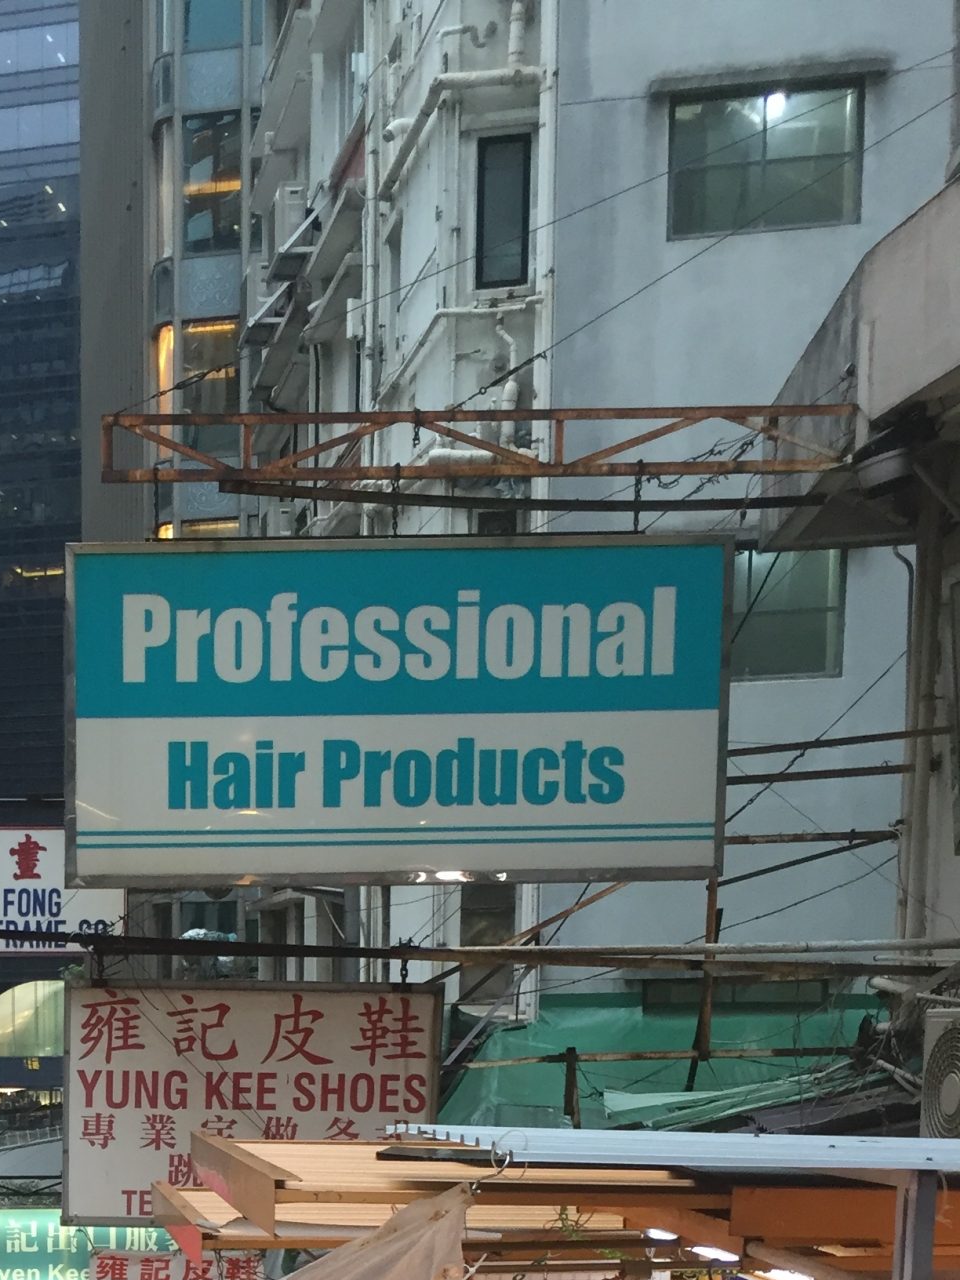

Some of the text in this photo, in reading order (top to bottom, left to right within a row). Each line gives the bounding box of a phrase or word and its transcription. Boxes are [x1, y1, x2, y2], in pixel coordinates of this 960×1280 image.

[121, 586, 677, 684] Professional
[167, 736, 626, 810] Hair Products
[2, 887, 62, 918] FONG
[77, 989, 428, 1067] 雍記皮鞋
[76, 1069, 427, 1113] YUNG KEE SHOES
